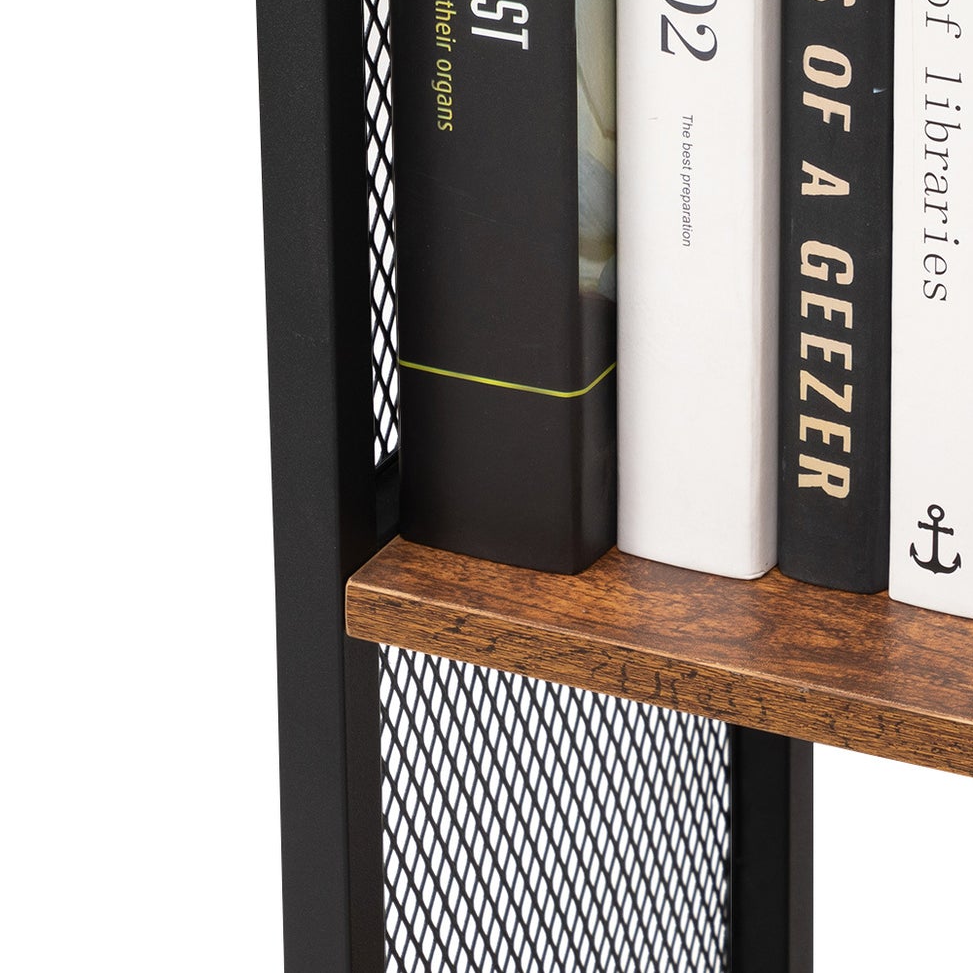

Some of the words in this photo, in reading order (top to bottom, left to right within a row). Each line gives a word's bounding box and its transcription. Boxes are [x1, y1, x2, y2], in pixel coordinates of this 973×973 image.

[431, 58, 454, 132] organs
[802, 44, 853, 132] OF
[681, 142, 693, 170] best
[682, 114, 694, 139] The
[680, 173, 693, 247] preparation
[800, 160, 851, 196] A
[922, 66, 963, 303] libraries
[798, 240, 855, 499] GEEZER
